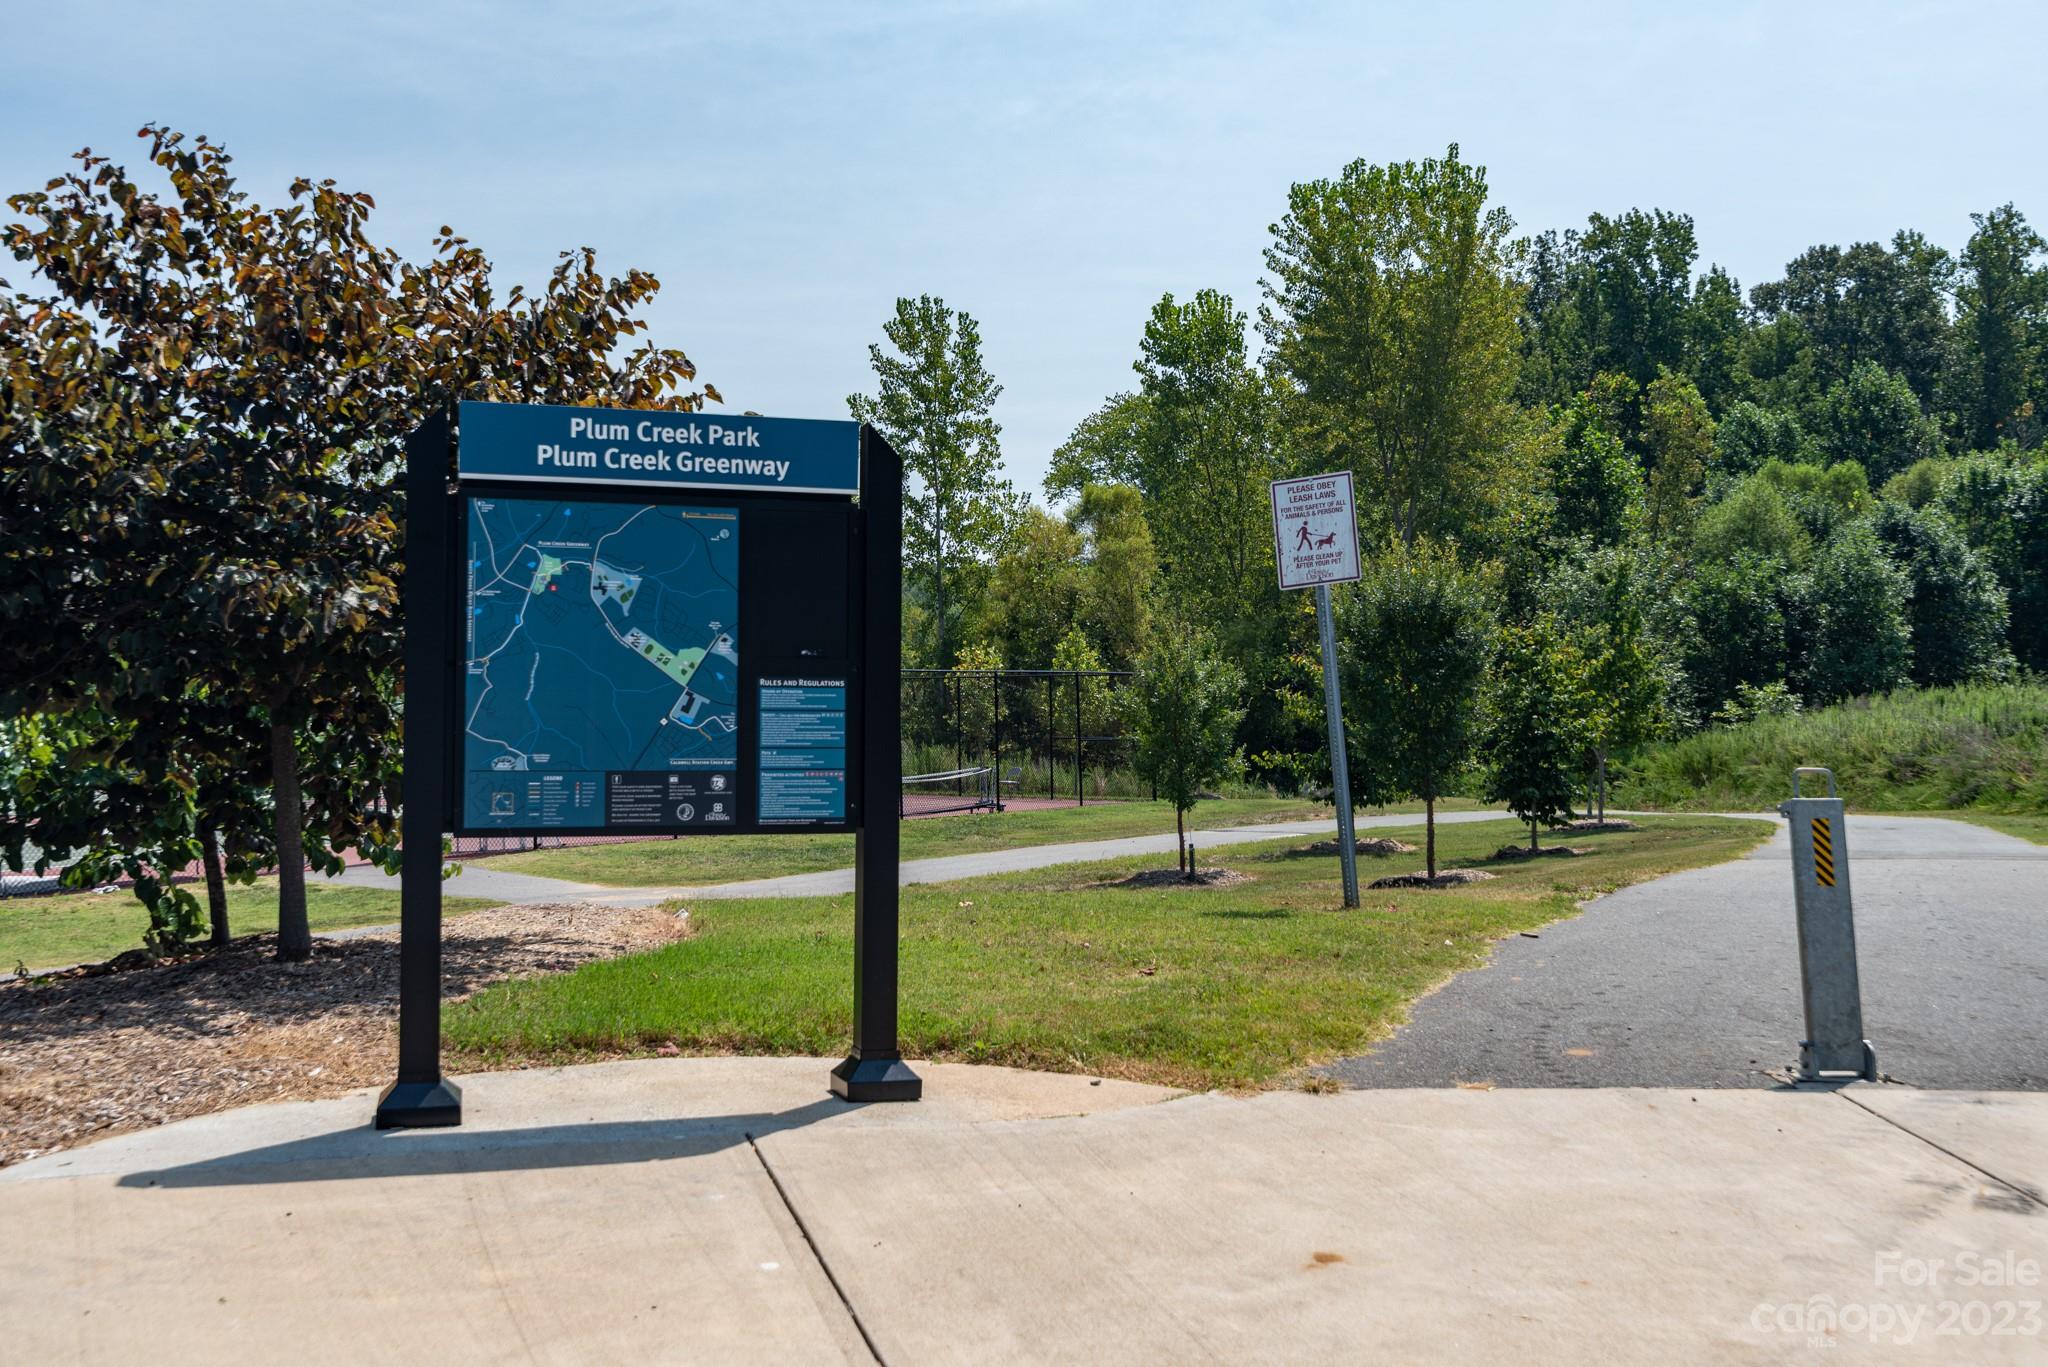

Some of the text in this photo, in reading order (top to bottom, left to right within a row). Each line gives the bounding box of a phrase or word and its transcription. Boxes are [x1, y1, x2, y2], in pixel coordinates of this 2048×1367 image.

[570, 417, 760, 447] Plum Creek Park
[537, 444, 790, 482] Plum Creek Greenway
[1287, 480, 1336, 494] PLEASE OBEY
[1289, 490, 1336, 503] LEASH LAWS
[1285, 511, 1310, 520] ANIMALS
[1317, 506, 1344, 515] PERSONS
[1304, 502, 1326, 511] SAFETY
[1293, 554, 1314, 563] PLEASE
[1315, 552, 1334, 560] CLEAN
[1331, 557, 1341, 565] PET
[760, 678, 782, 687] RULES
[798, 679, 845, 687] REGULATIONS
